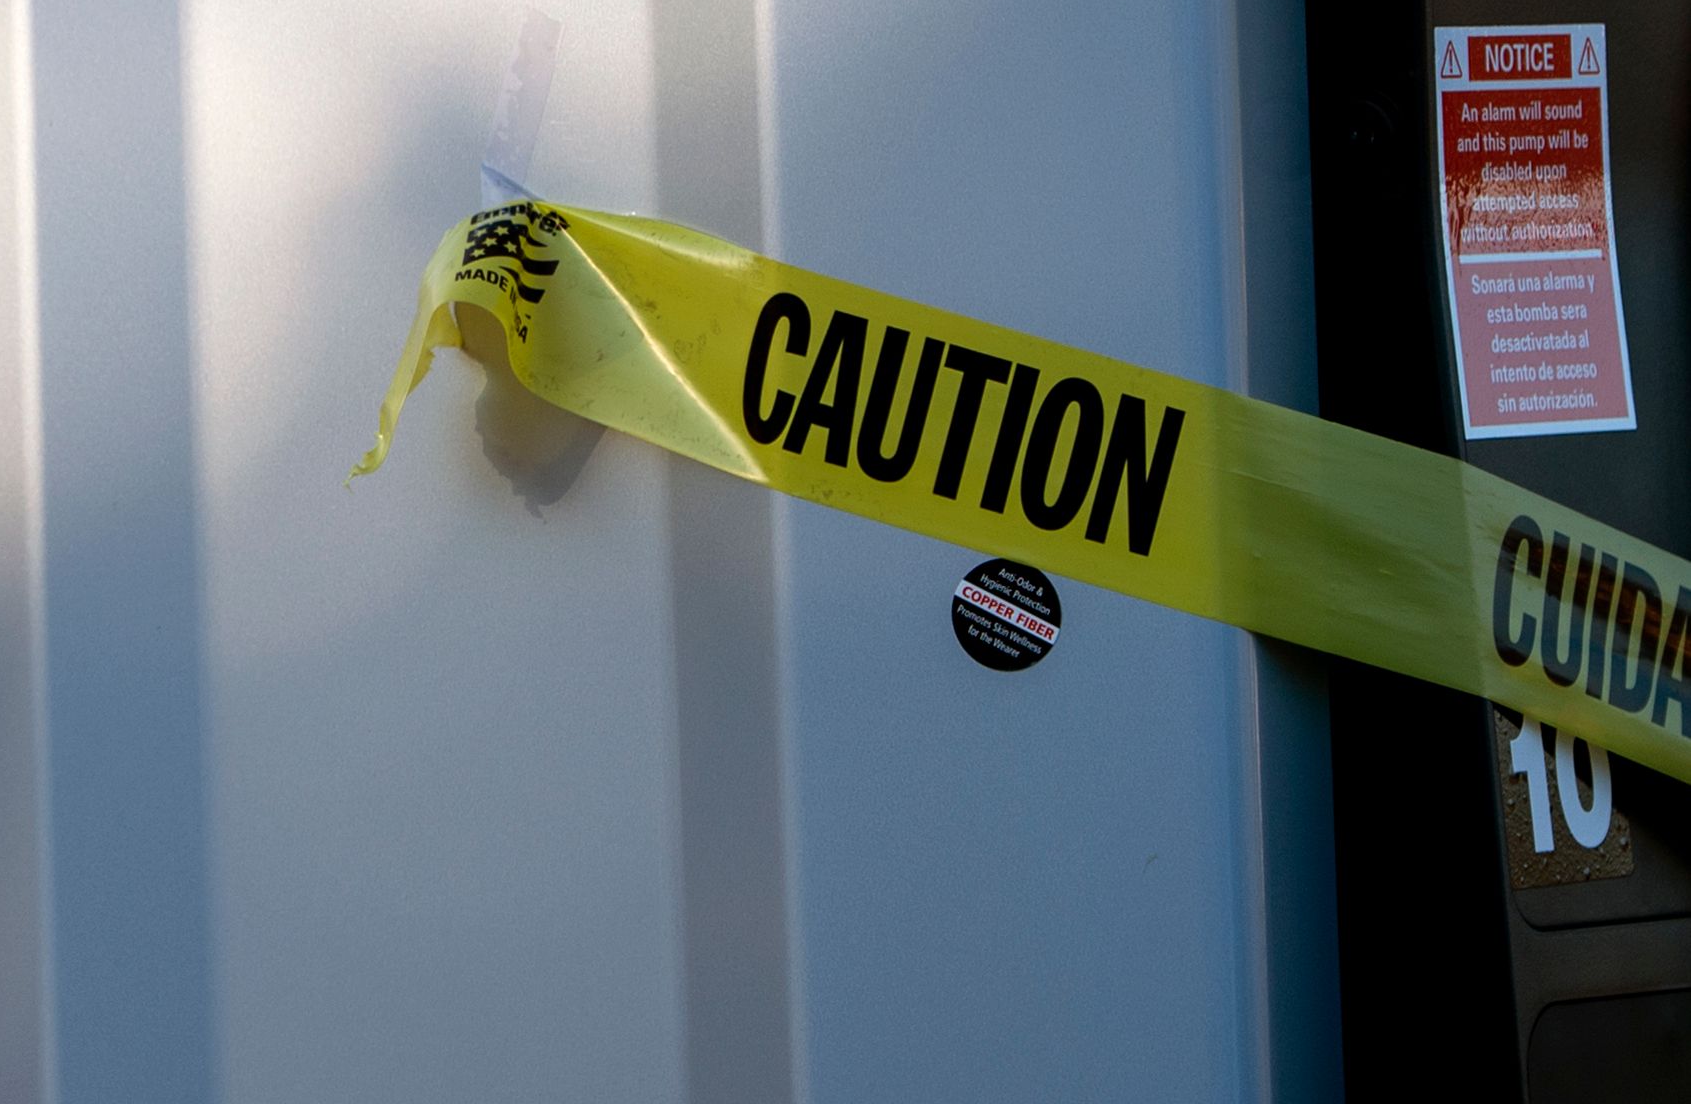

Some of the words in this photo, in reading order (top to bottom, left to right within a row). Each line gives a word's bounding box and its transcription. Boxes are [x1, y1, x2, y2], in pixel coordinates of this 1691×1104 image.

[1485, 43, 1555, 72] NOTICE
[1461, 103, 1478, 122] An
[1481, 102, 1516, 121] alarm
[1519, 101, 1542, 120] will
[1545, 100, 1582, 120] sound
[1457, 132, 1480, 152] and
[1482, 131, 1506, 151] this
[1510, 136, 1545, 155] pump
[1548, 129, 1570, 148] will
[1573, 129, 1588, 148] be
[1481, 161, 1532, 181] disabled
[1536, 163, 1567, 184] upon
[1472, 192, 1536, 213] attempted
[1539, 193, 1580, 209] access
[1461, 224, 1509, 242] without
[455, 268, 509, 293] MADE
[1471, 273, 1515, 294] Sonará
[1518, 276, 1541, 292] una
[1543, 271, 1585, 291] alarma
[1588, 274, 1595, 293] y
[1487, 305, 1514, 324] esta
[1514, 302, 1559, 322] bomba
[1561, 304, 1588, 319] sera
[1491, 331, 1576, 353] desactivatada
[1578, 329, 1590, 349] al
[1490, 363, 1536, 384] intento
[1538, 361, 1554, 381] de
[1556, 362, 1597, 380] acceso
[1497, 393, 1517, 413] sin
[1519, 388, 1598, 412] autorización.
[741, 292, 1187, 558] CAUTION
[980, 574, 1012, 597] Hygienic
[1012, 590, 1051, 615] Protection
[998, 568, 1035, 592] Anti-Odor
[1036, 587, 1044, 596] &
[962, 586, 1014, 620] COPPER
[1016, 612, 1055, 640] FIBER
[957, 604, 992, 628] Promotes
[992, 622, 1009, 637] Skin
[1010, 631, 1042, 654] Wellness
[968, 624, 979, 637] for
[980, 631, 993, 645] the
[993, 638, 1020, 658] Wearer
[1510, 712, 1613, 853] 10
